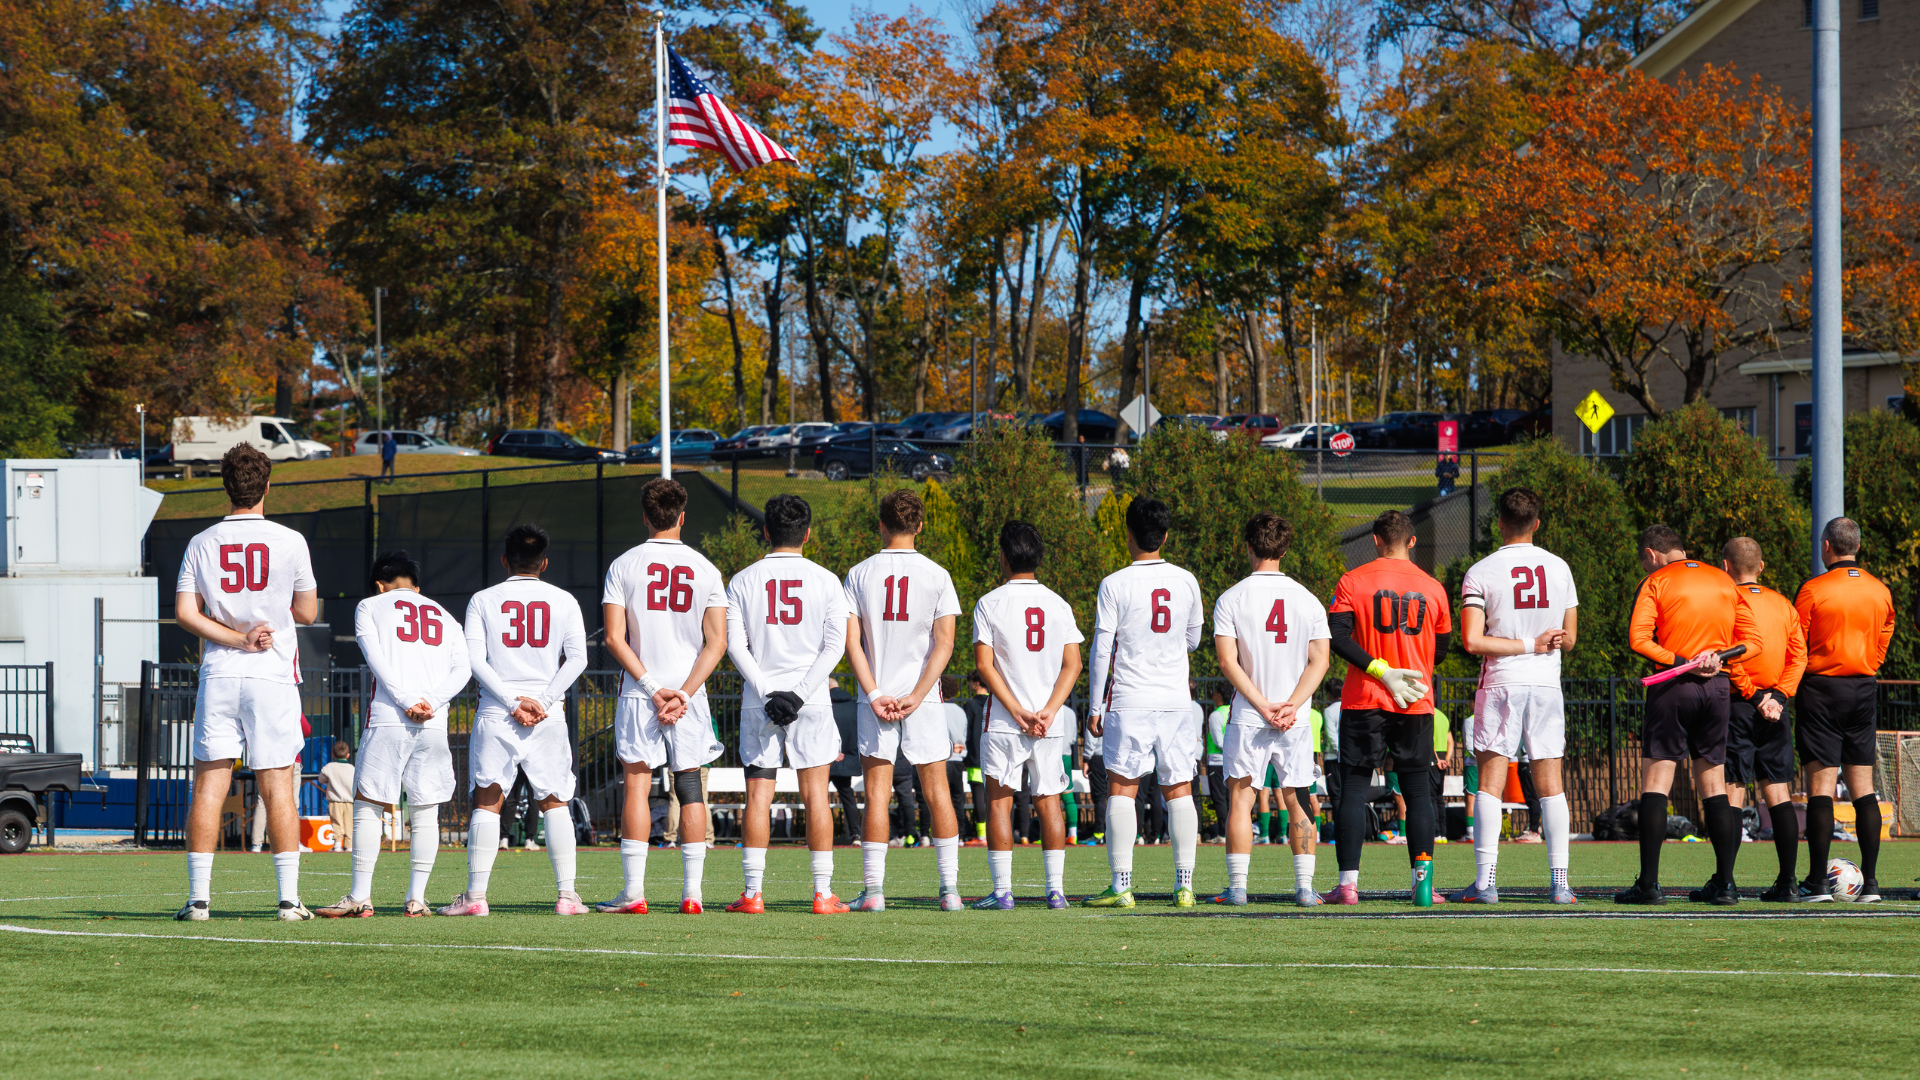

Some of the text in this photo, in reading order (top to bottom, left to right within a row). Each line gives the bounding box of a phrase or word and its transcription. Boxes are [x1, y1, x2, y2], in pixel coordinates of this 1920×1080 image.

[1332, 437, 1353, 450] STOP
[220, 543, 270, 594] 50
[647, 563, 694, 613] 26
[1512, 565, 1550, 610] 21
[765, 579, 803, 626] 15
[883, 575, 910, 622] 11
[1150, 588, 1171, 633] 6
[1265, 599, 1288, 644] 4
[1372, 588, 1429, 636] 00
[394, 600, 444, 647] 36
[501, 600, 551, 648] 30
[1025, 607, 1045, 652] 8
[317, 824, 335, 846] G
